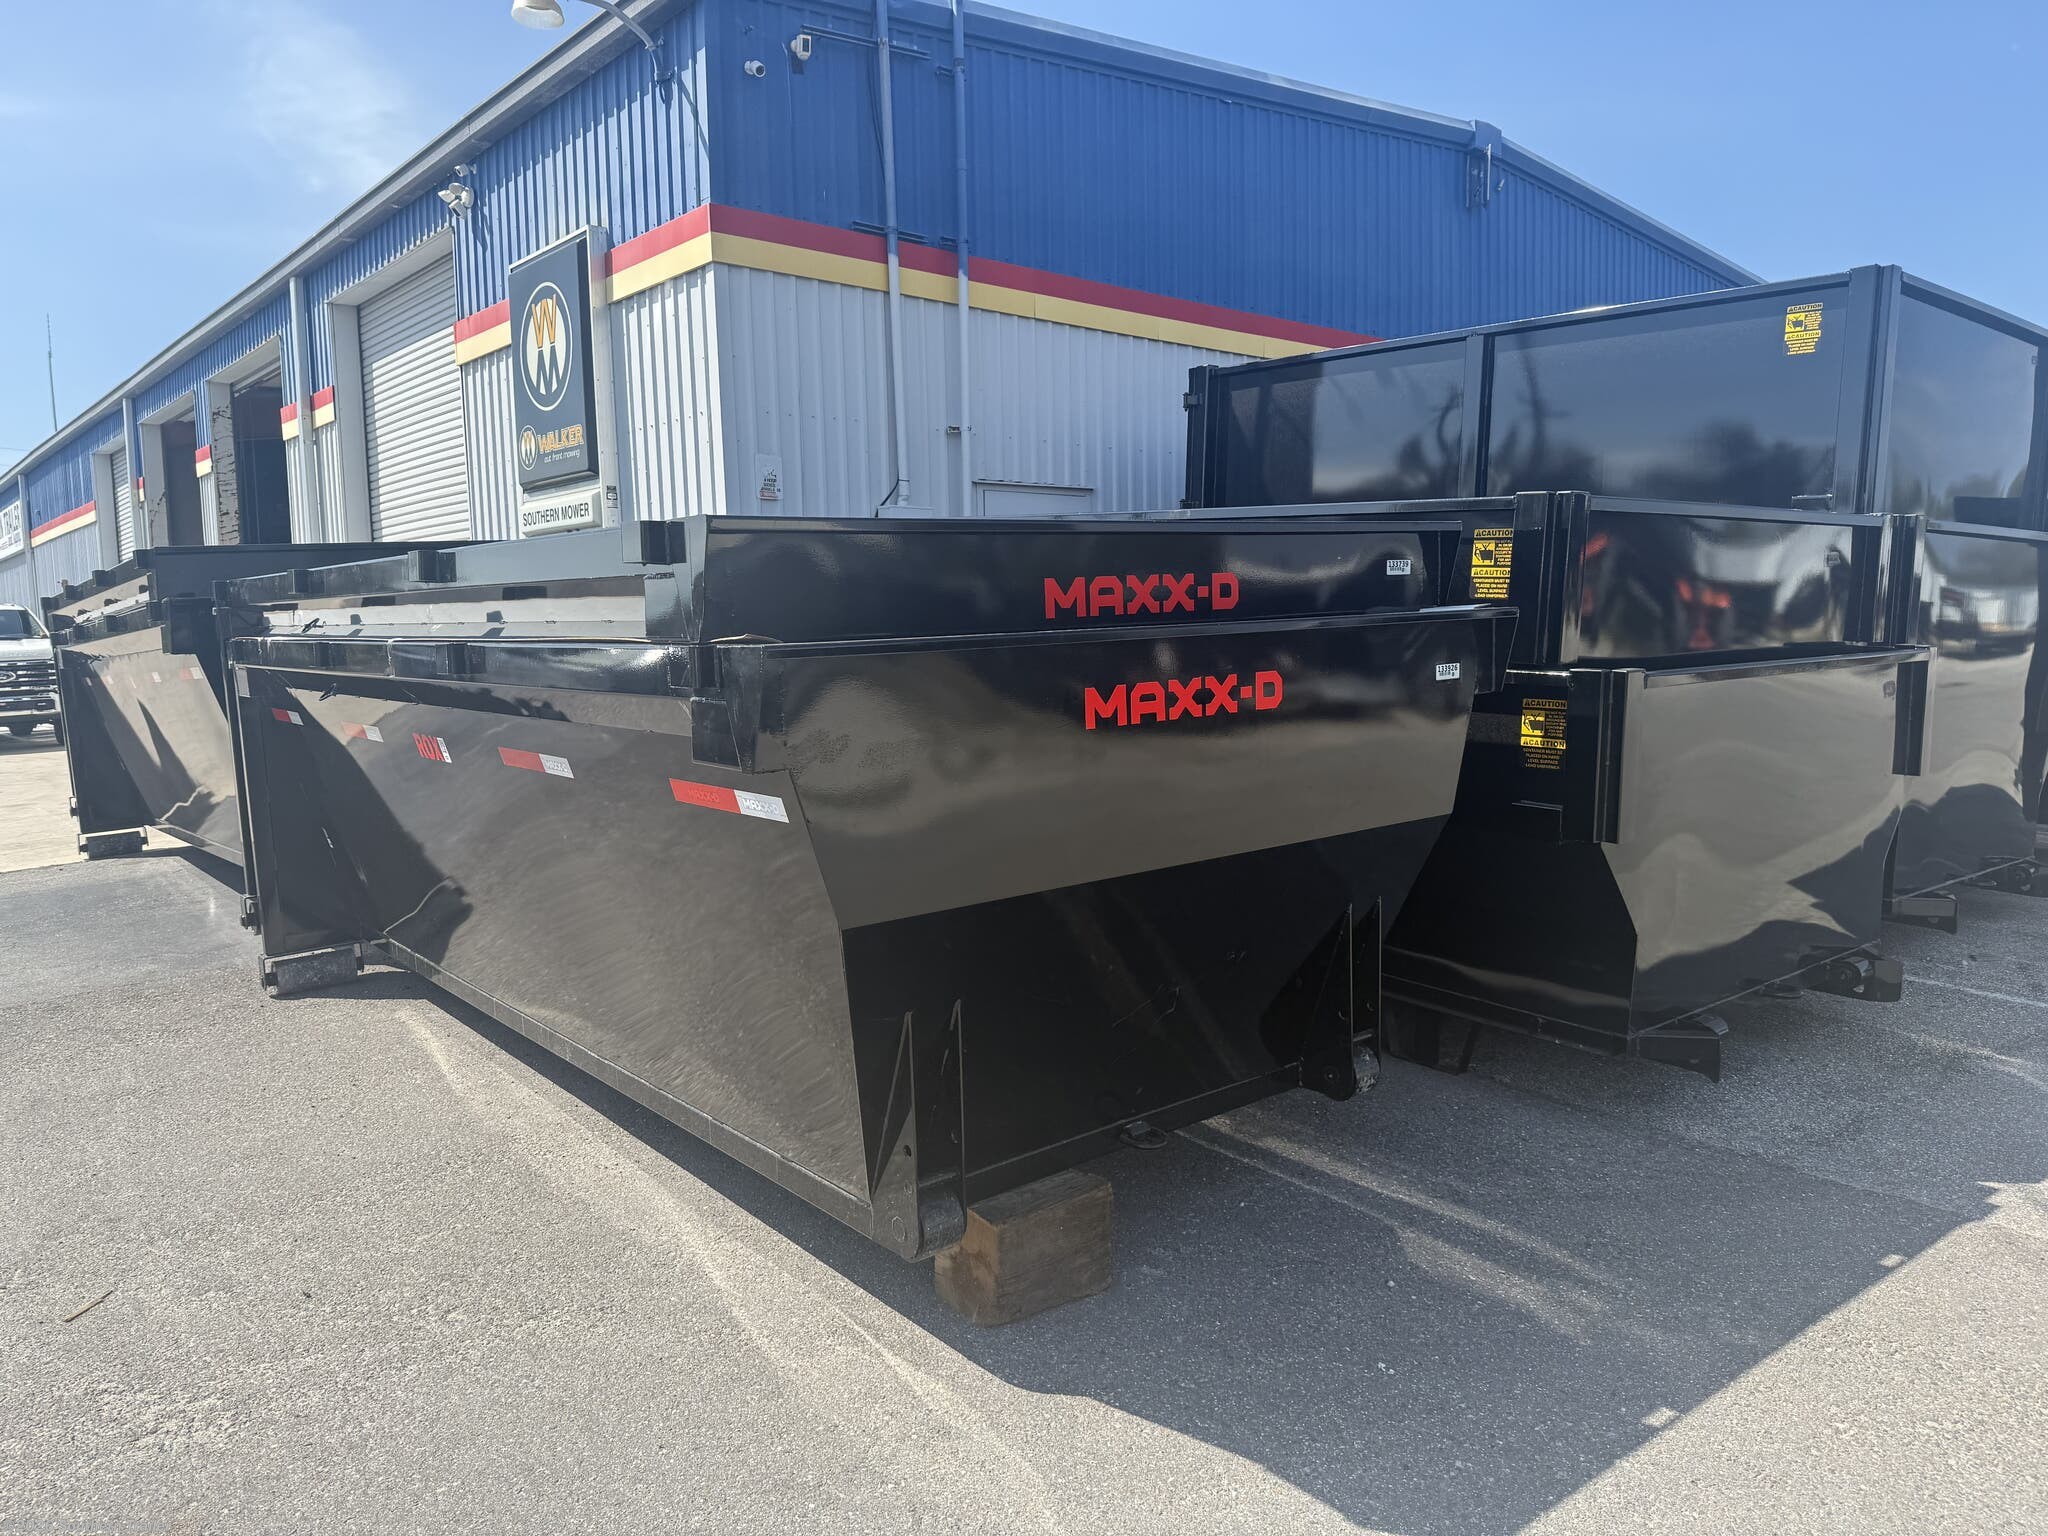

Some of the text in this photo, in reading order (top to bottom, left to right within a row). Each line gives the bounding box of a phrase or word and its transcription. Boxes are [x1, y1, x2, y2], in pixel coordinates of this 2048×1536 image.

[1793, 303, 1822, 311] CAUTION
[537, 424, 584, 454] WALKER
[522, 502, 590, 527] SOUTHERN MOWER
[1044, 572, 1239, 619] MAXX-D
[1084, 670, 1283, 730] MAXX-D
[1530, 700, 1566, 708] CAUTION
[1528, 739, 1565, 748] CAUTION
[742, 798, 780, 815] MAXX-D
